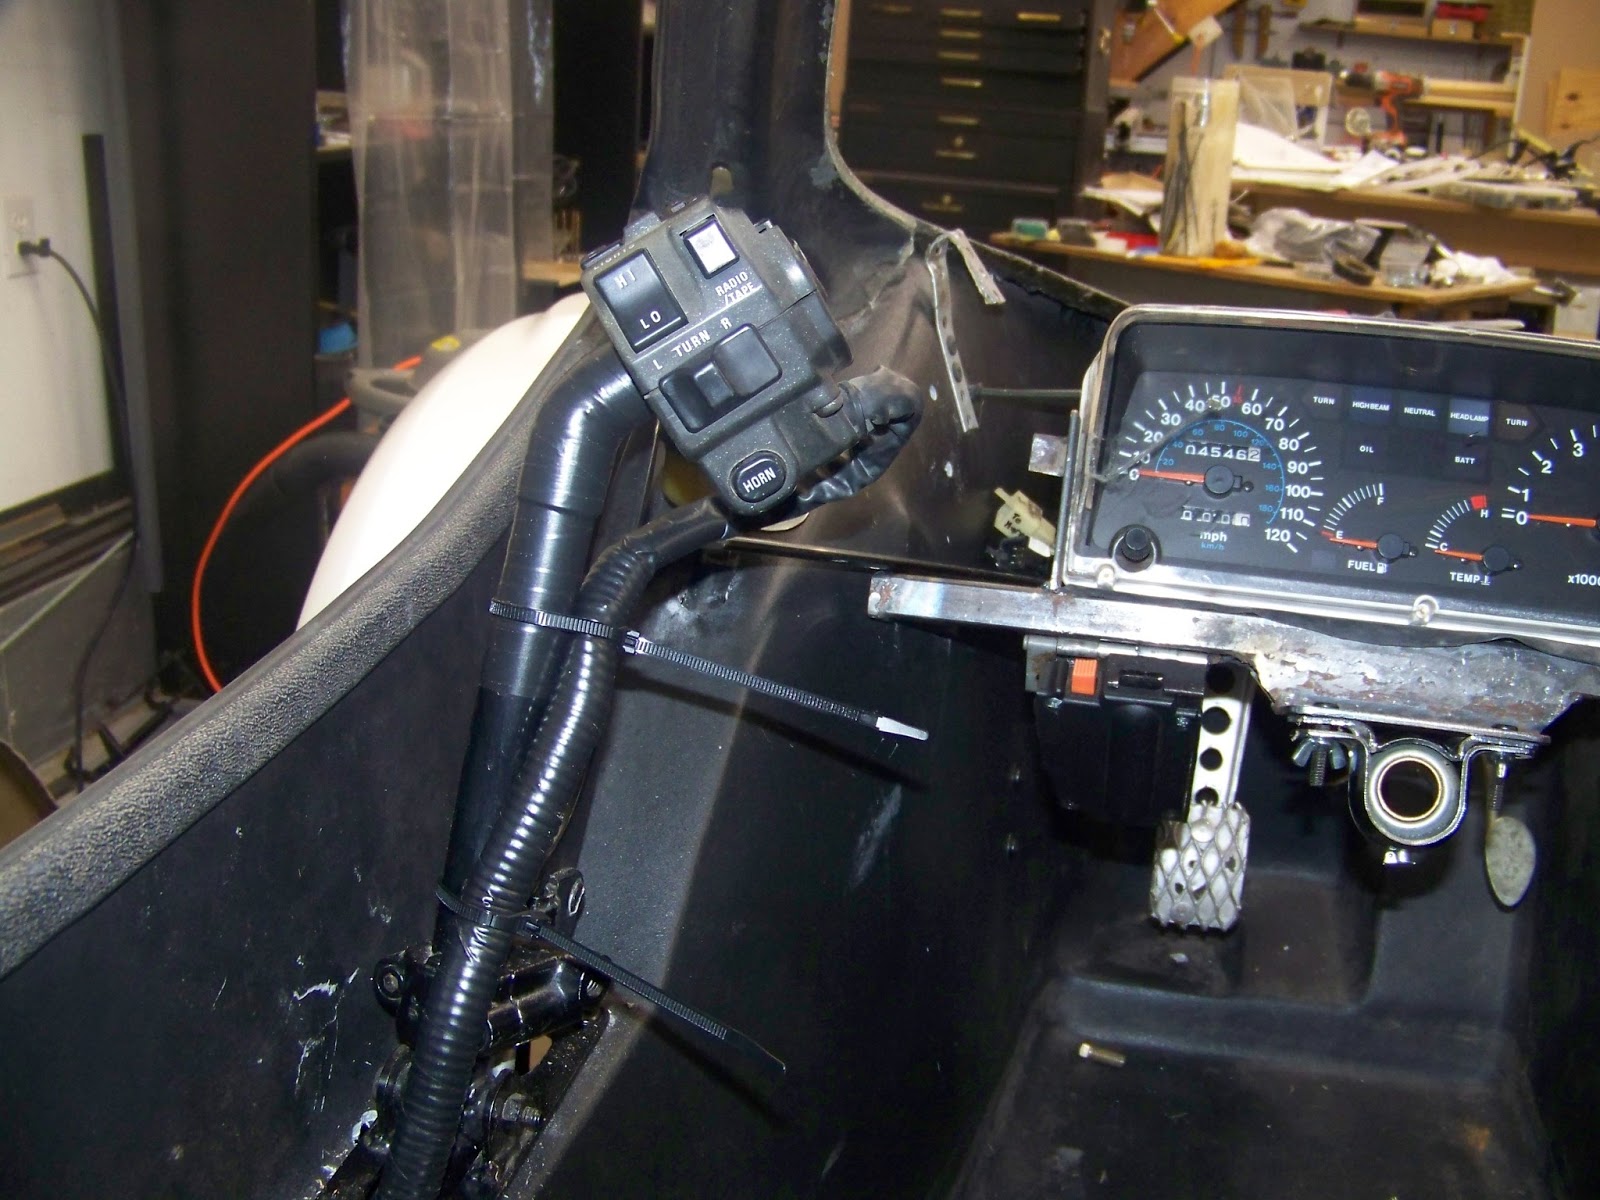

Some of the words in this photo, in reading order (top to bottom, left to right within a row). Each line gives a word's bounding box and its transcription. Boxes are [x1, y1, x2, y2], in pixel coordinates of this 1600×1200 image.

[614, 269, 637, 289] HI
[715, 271, 748, 296] RADIO
[640, 310, 662, 331] LO
[652, 359, 663, 371] L
[671, 329, 711, 358] TURN
[720, 317, 733, 330] R
[1184, 399, 1205, 412] 40
[1313, 396, 1335, 405] TURN
[1241, 402, 1262, 416] 60
[1404, 406, 1436, 417] NEUTRAL
[1161, 413, 1181, 426] 30
[1450, 412, 1489, 423] HEADLAMP
[1506, 418, 1528, 427] TURN
[1265, 418, 1284, 431] 70
[1143, 430, 1164, 443] 20
[1278, 438, 1299, 451] 80
[1359, 445, 1374, 453] OIL
[1573, 443, 1584, 457] 3
[1455, 456, 1475, 465] BATT
[1541, 460, 1552, 474] 2
[1129, 468, 1140, 480] 0
[1287, 461, 1308, 474] 90
[742, 467, 777, 494] HORN
[1285, 485, 1310, 498] 100
[1522, 489, 1530, 502] 1
[1376, 497, 1384, 506] F
[1280, 508, 1304, 521] 110
[1480, 509, 1489, 518] H
[1516, 511, 1528, 525] 0
[1200, 532, 1227, 543] mph
[1264, 529, 1290, 542] 120
[1336, 531, 1343, 540] E
[1439, 542, 1448, 551] C
[1347, 560, 1376, 572] FUEL
[1450, 572, 1480, 584] TEMP
